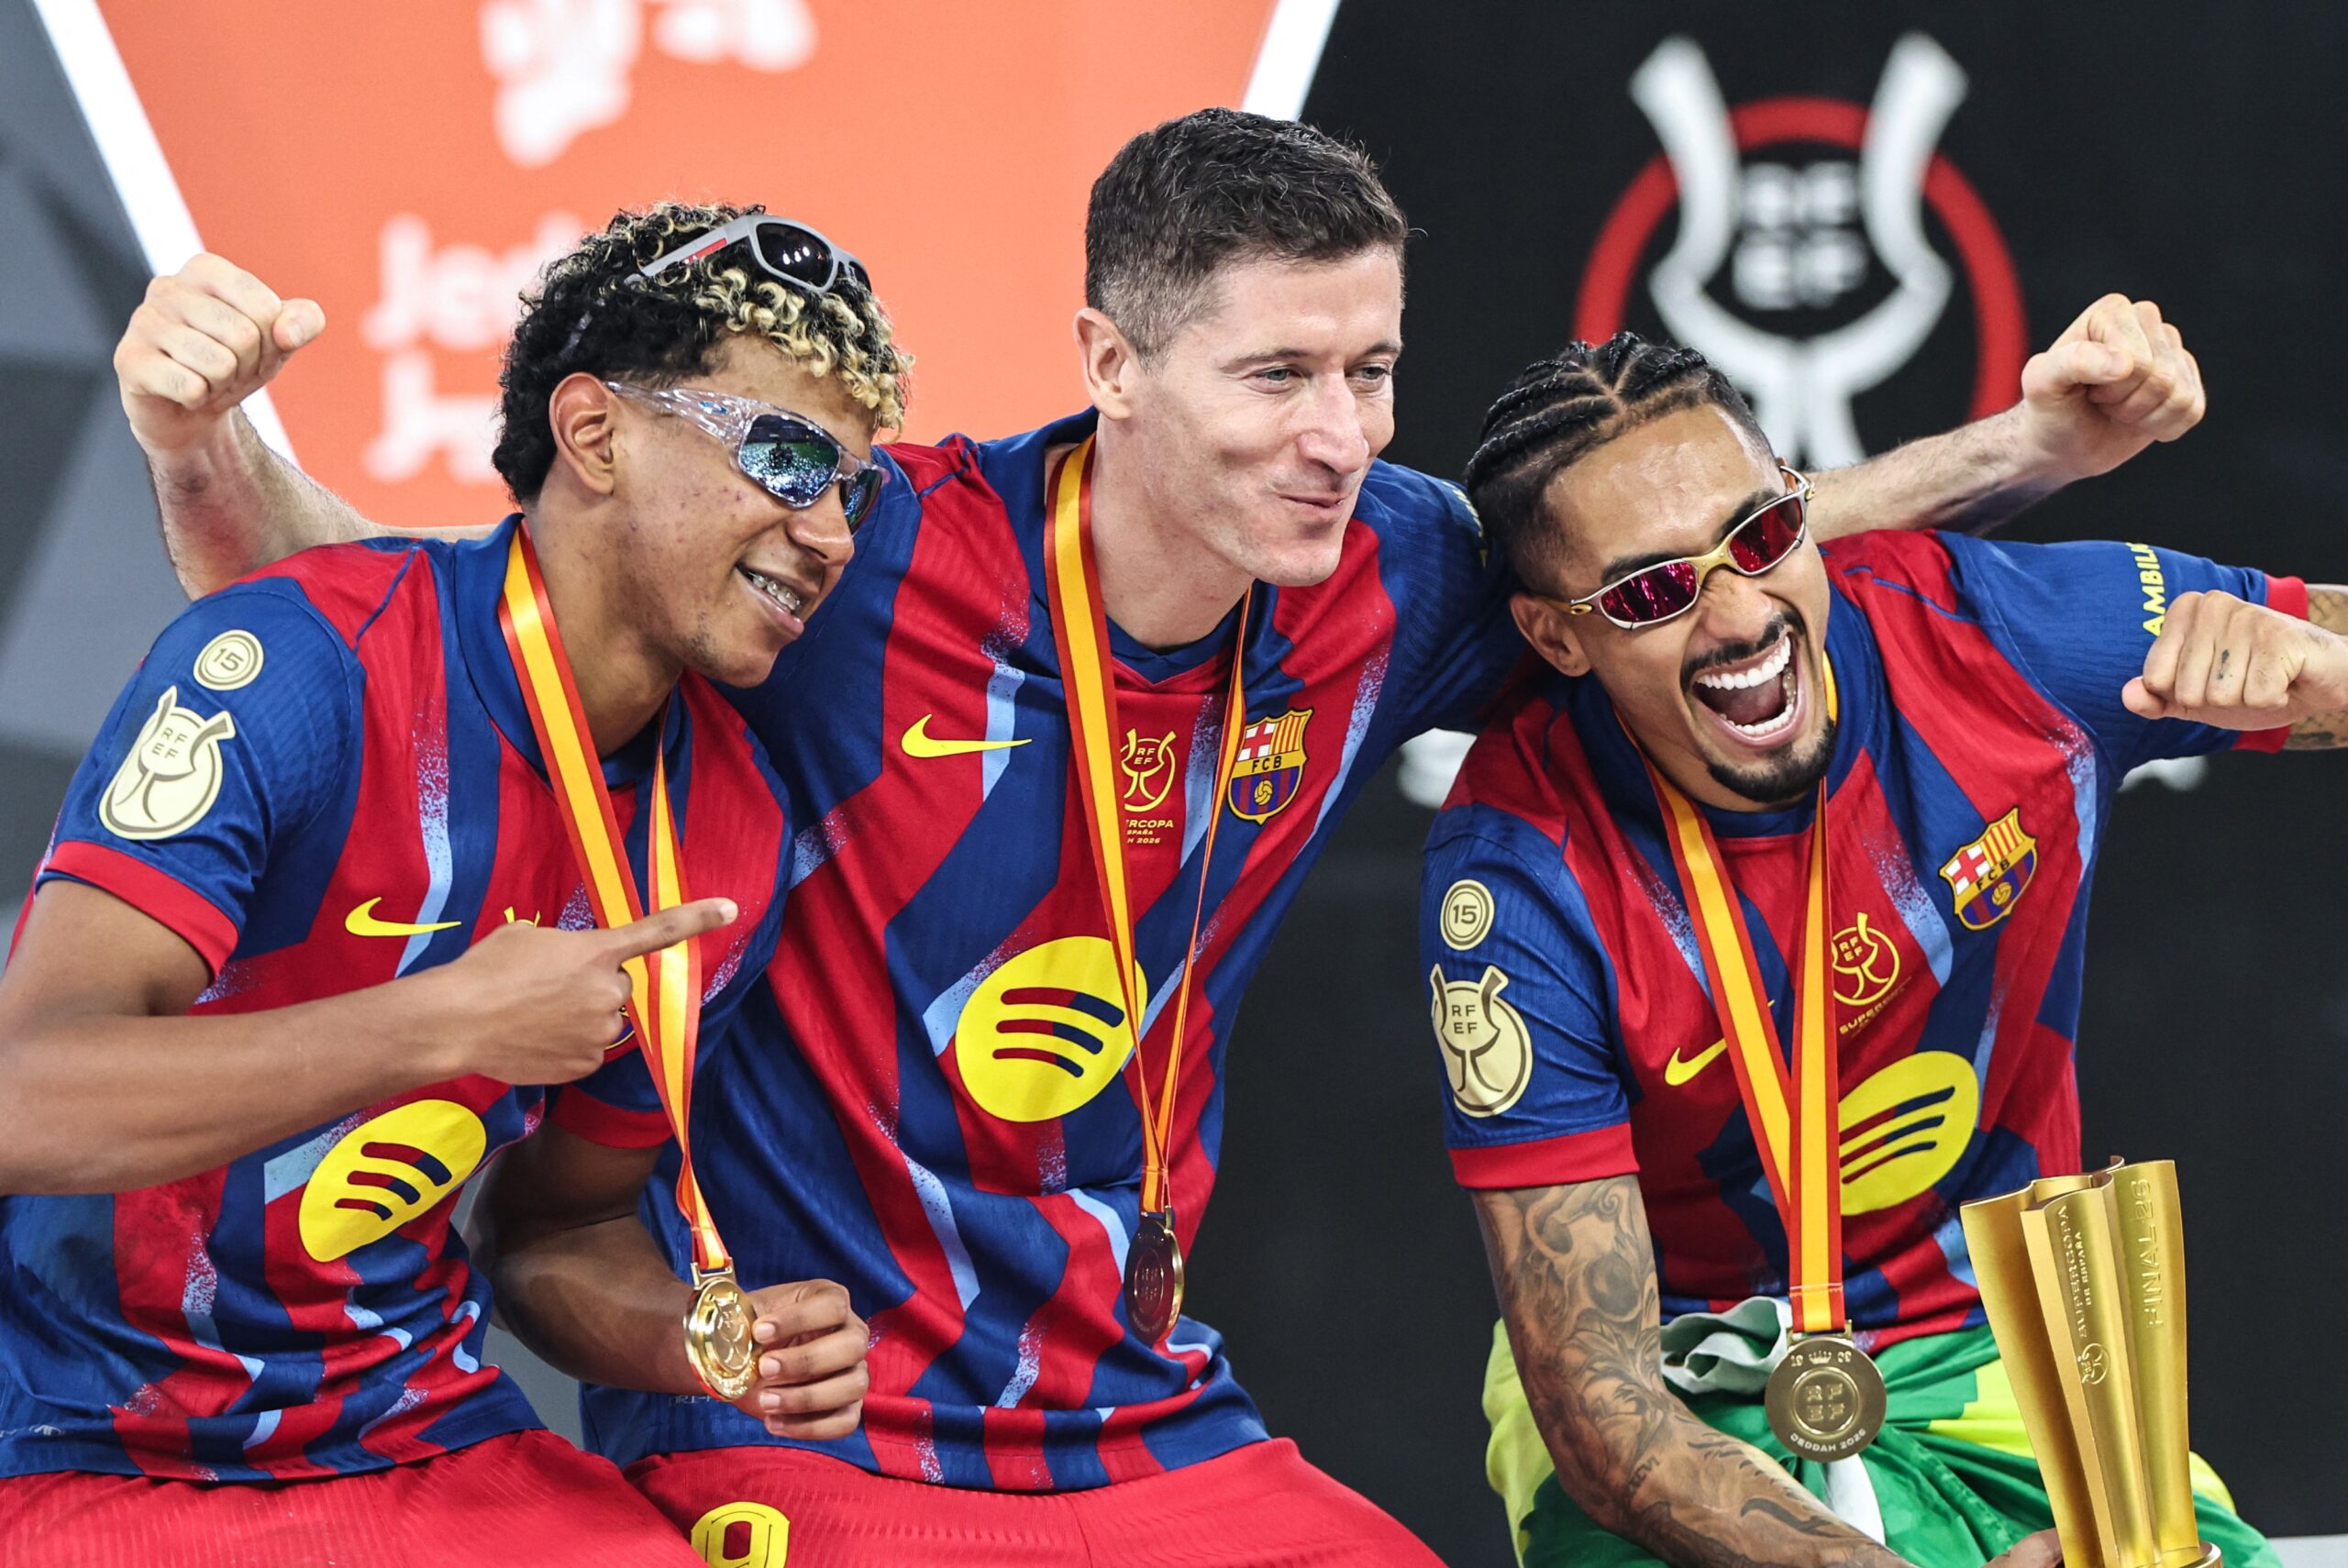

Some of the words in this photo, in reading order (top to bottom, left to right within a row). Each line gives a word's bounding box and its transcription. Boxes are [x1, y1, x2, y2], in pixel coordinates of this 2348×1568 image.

[213, 647, 244, 672] 15
[162, 727, 188, 745] RF
[152, 744, 179, 760] EF
[1136, 747, 1156, 756] RF
[1134, 756, 1153, 766] EF
[1251, 756, 1282, 773] FCB
[1125, 819, 1174, 829] RCOPA
[1976, 858, 2011, 891] FCB
[1452, 903, 1478, 925] 15
[1839, 936, 1860, 953] RF
[1844, 947, 1864, 963] EF
[1452, 1004, 1476, 1017] RF
[1454, 1021, 1478, 1034] EF
[1789, 1431, 1837, 1452] JEDDAH
[1840, 1429, 1867, 1450] 2026
